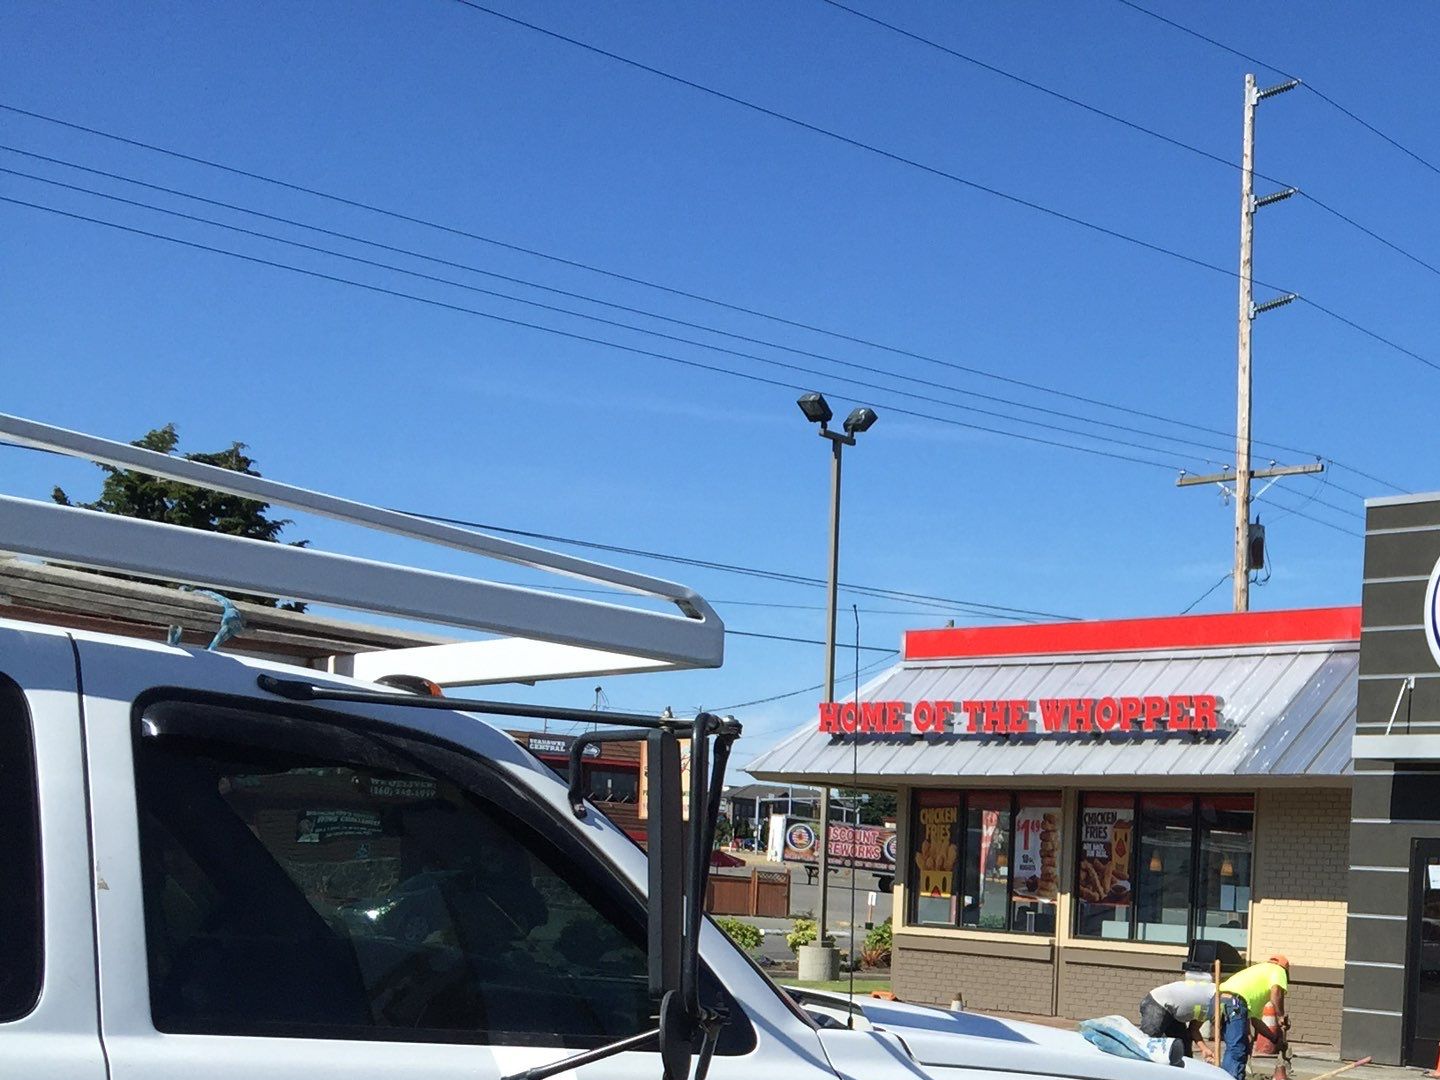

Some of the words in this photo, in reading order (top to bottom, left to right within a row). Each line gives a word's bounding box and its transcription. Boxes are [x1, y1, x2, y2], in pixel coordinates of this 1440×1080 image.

[819, 701, 904, 734] HOME
[914, 701, 952, 733] OF
[963, 699, 1029, 733] THE
[1040, 694, 1220, 732] WHOPPER
[529, 743, 566, 752] CENTRAL
[920, 807, 957, 824] CHICKEN
[1084, 811, 1117, 825] CHICKEN
[828, 826, 879, 846] SCOUNT
[926, 824, 951, 838] FRIES
[1086, 826, 1108, 839] FRIES
